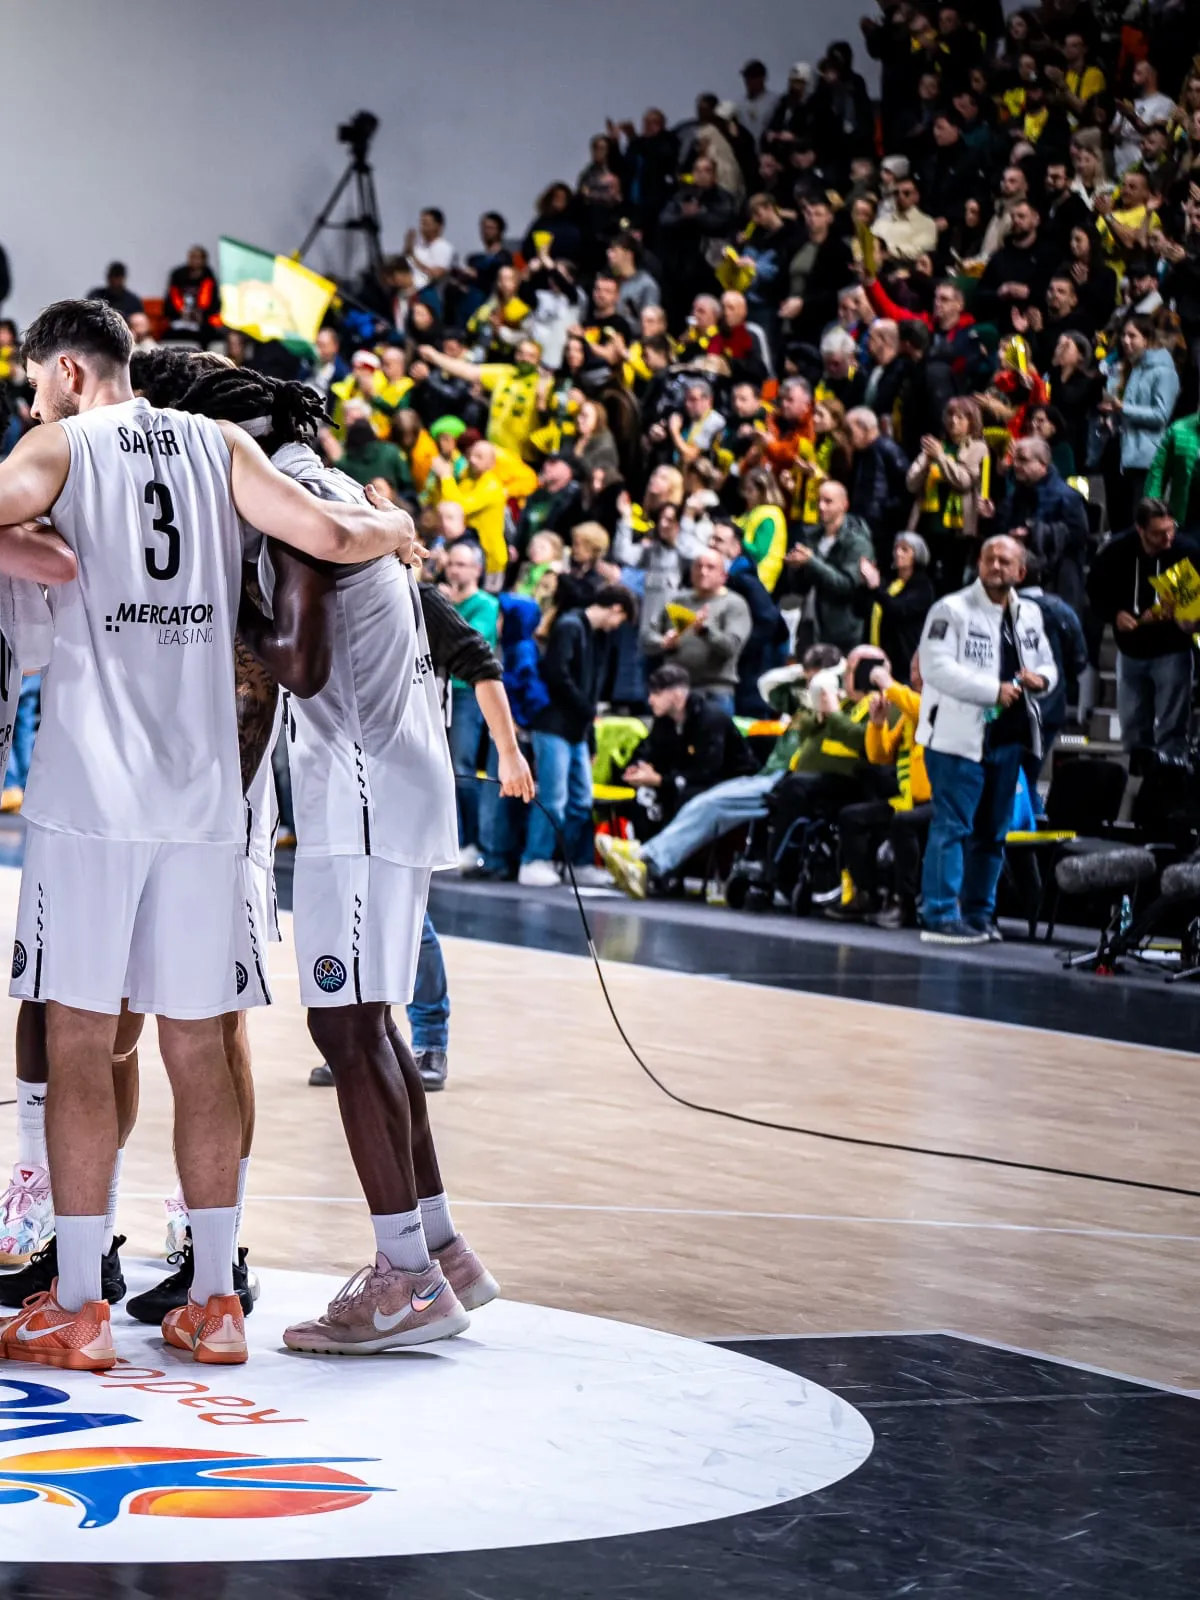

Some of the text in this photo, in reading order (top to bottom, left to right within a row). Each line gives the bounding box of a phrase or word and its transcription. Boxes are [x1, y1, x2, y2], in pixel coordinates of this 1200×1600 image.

[144, 480, 180, 581] 3
[115, 602, 213, 625] MERCATOR
[158, 627, 213, 646] LEASING
